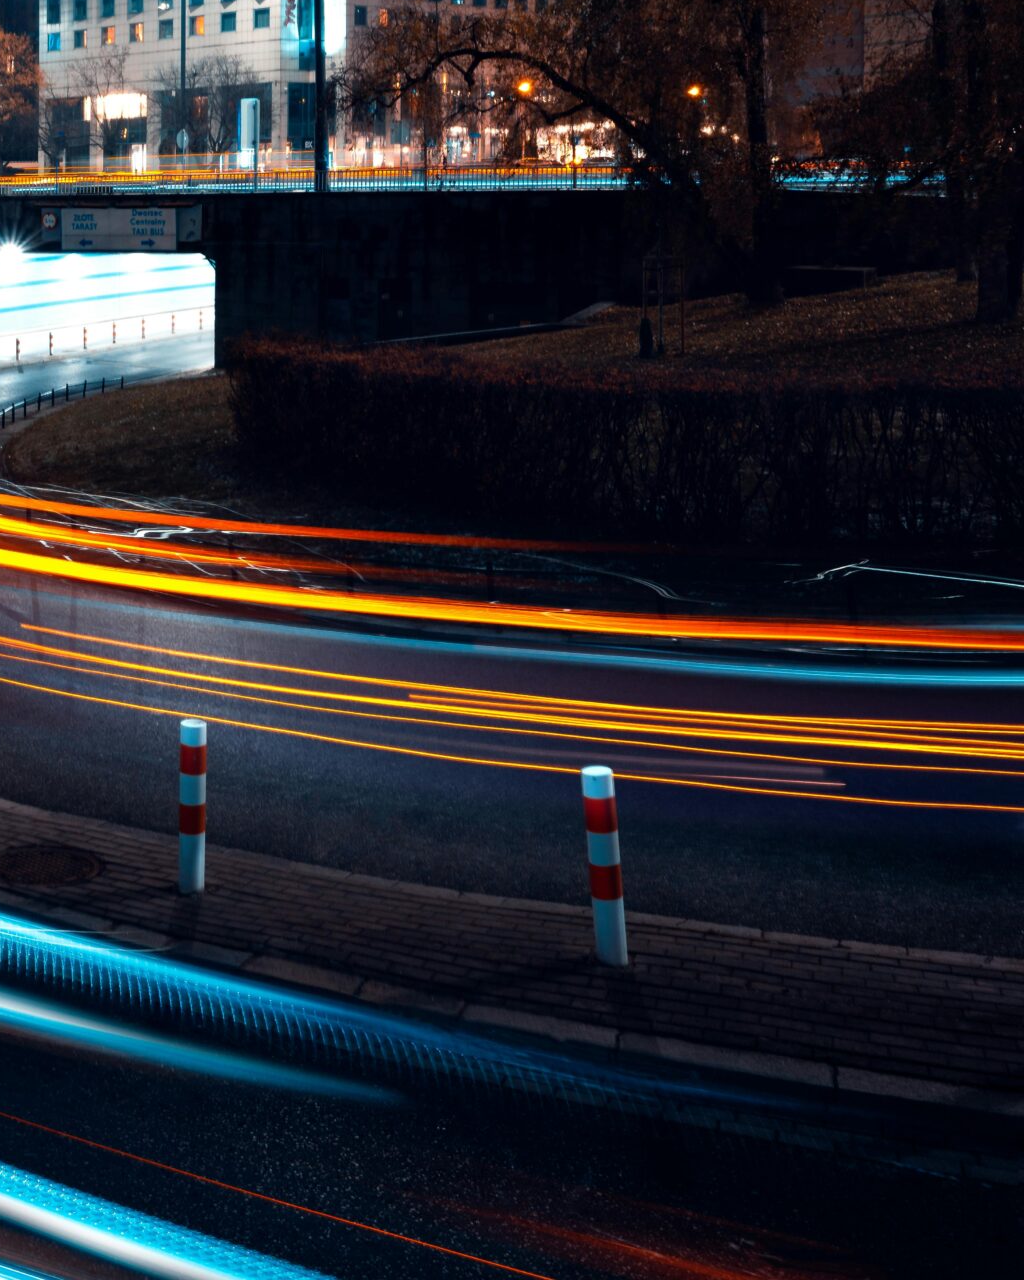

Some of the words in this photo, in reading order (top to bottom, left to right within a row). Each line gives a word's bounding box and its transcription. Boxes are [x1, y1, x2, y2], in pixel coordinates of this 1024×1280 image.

[132, 208, 163, 216] Dworzec
[130, 218, 166, 226] Centralny
[132, 227, 147, 236] TAXI
[150, 227, 164, 236] BUS
